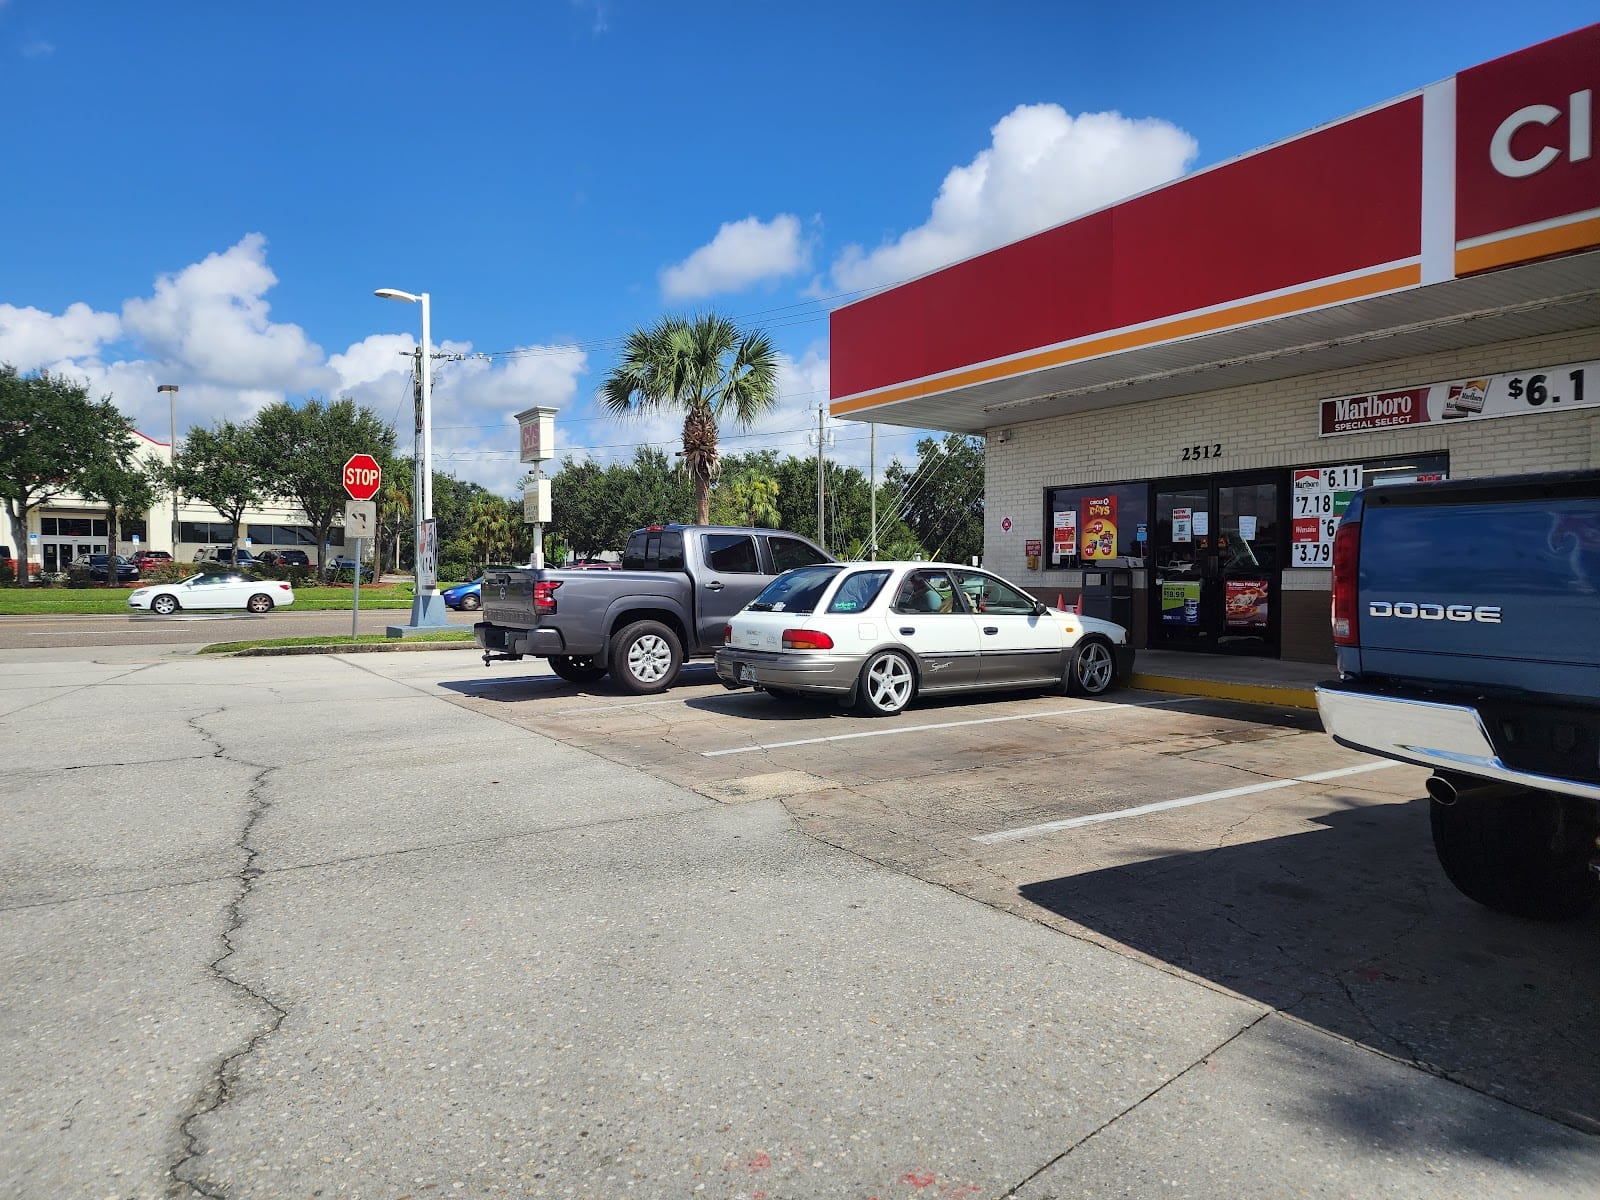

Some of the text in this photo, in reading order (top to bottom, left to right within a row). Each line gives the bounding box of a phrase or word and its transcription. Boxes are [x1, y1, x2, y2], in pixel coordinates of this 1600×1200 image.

[1490, 89, 1592, 178] CI
[1508, 369, 1585, 406] $6.1
[1334, 394, 1412, 422] Marlboro
[1334, 415, 1411, 432] SPECIAL SELECT
[522, 423, 540, 447] CVS
[1182, 443, 1223, 461] 2512
[346, 468, 379, 486] STOP
[1295, 479, 1320, 489] Marlboro
[1323, 468, 1359, 488] $6.11
[1089, 504, 1111, 516] DAYS
[1296, 495, 1331, 514] $7.18
[1295, 544, 1330, 562] $3.79
[1369, 601, 1502, 623] DODGE
